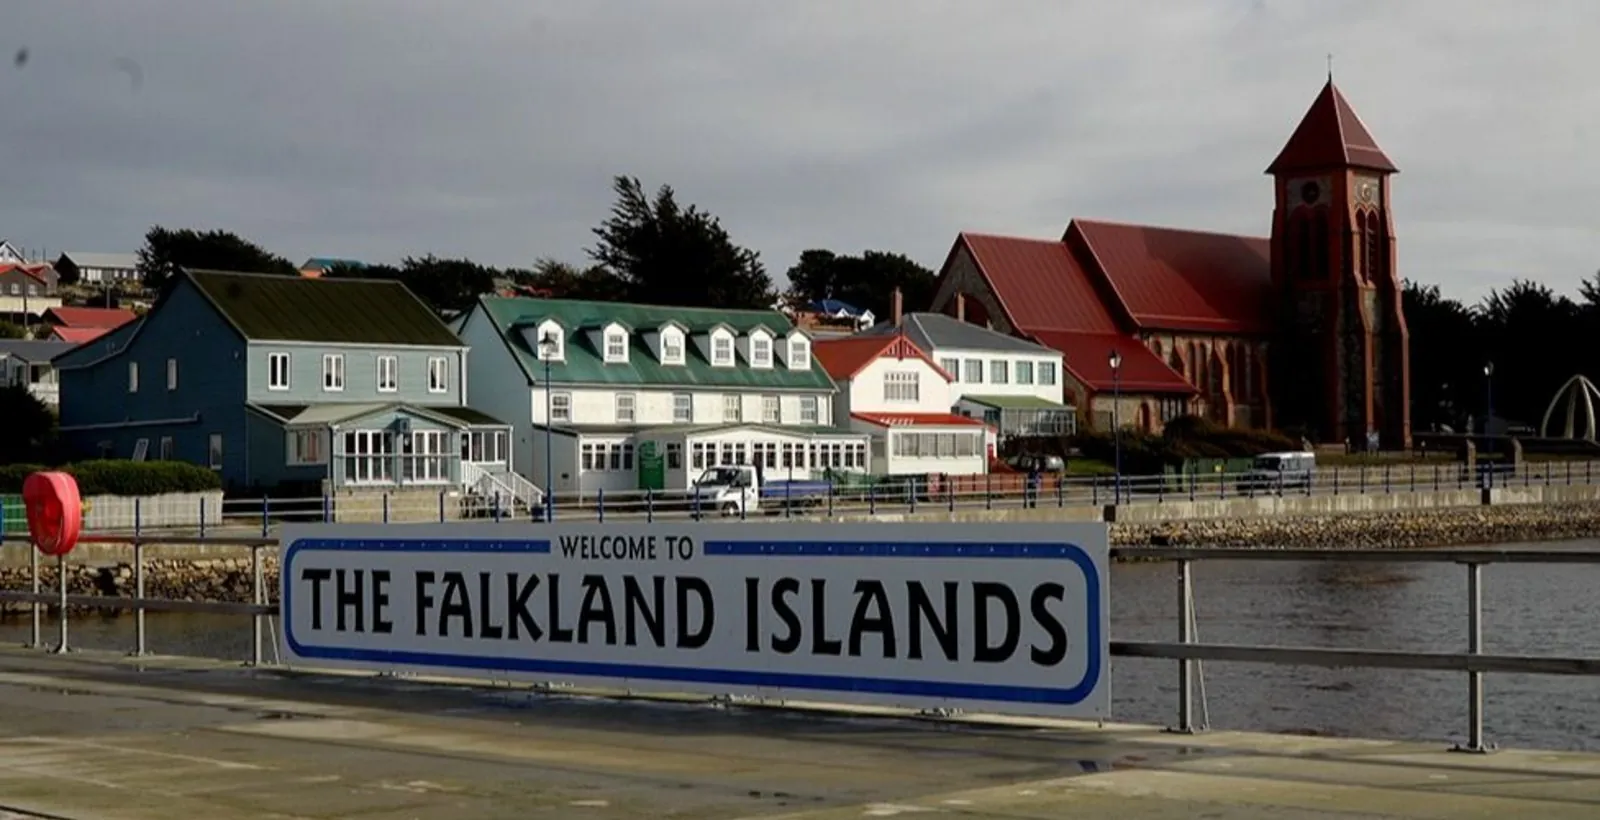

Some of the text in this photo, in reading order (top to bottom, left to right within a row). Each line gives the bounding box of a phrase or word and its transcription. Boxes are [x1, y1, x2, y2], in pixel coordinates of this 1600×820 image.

[559, 535, 694, 561] WELCOME TO
[301, 567, 1068, 668] THE FALKLAND ISLANDS
